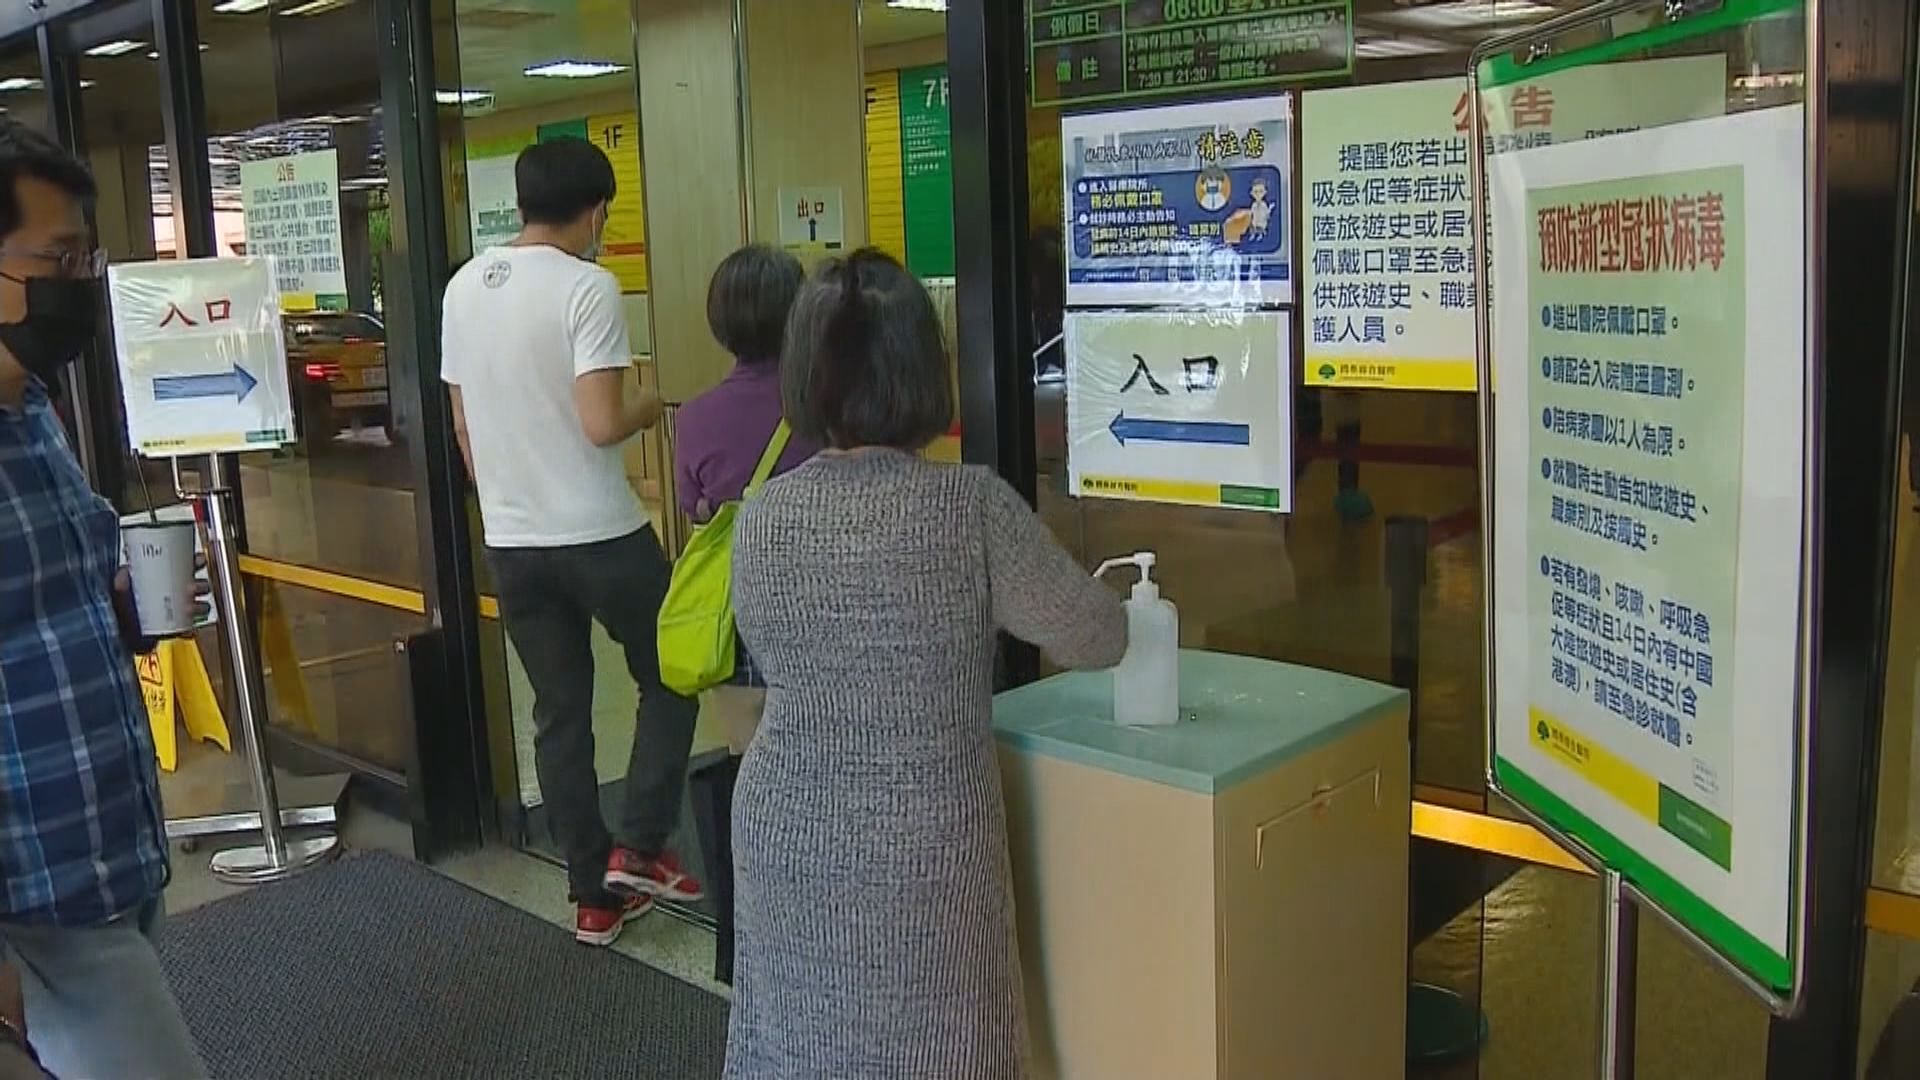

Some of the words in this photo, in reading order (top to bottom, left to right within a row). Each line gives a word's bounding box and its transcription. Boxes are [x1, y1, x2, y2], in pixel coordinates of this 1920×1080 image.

[1050, 13, 1100, 36] 例假日
[1452, 86, 1555, 132] 公告
[603, 124, 623, 149] 1F
[1198, 129, 1265, 160] 請注意
[276, 162, 295, 182] 公告
[797, 197, 824, 217] 出口
[1538, 190, 1725, 273] 預防新型冠狀病毒
[159, 299, 231, 328] 入口
[1313, 316, 1405, 344] 護人員。
[1119, 353, 1219, 395] 入口
[1553, 356, 1694, 399] 請配合入院體溫量測。
[1553, 406, 1685, 456] 陪病家屬以1人為限。
[1551, 495, 1658, 551] 職業別及接觸史。
[1551, 591, 1713, 687] 促等症狀且14日內有中國
